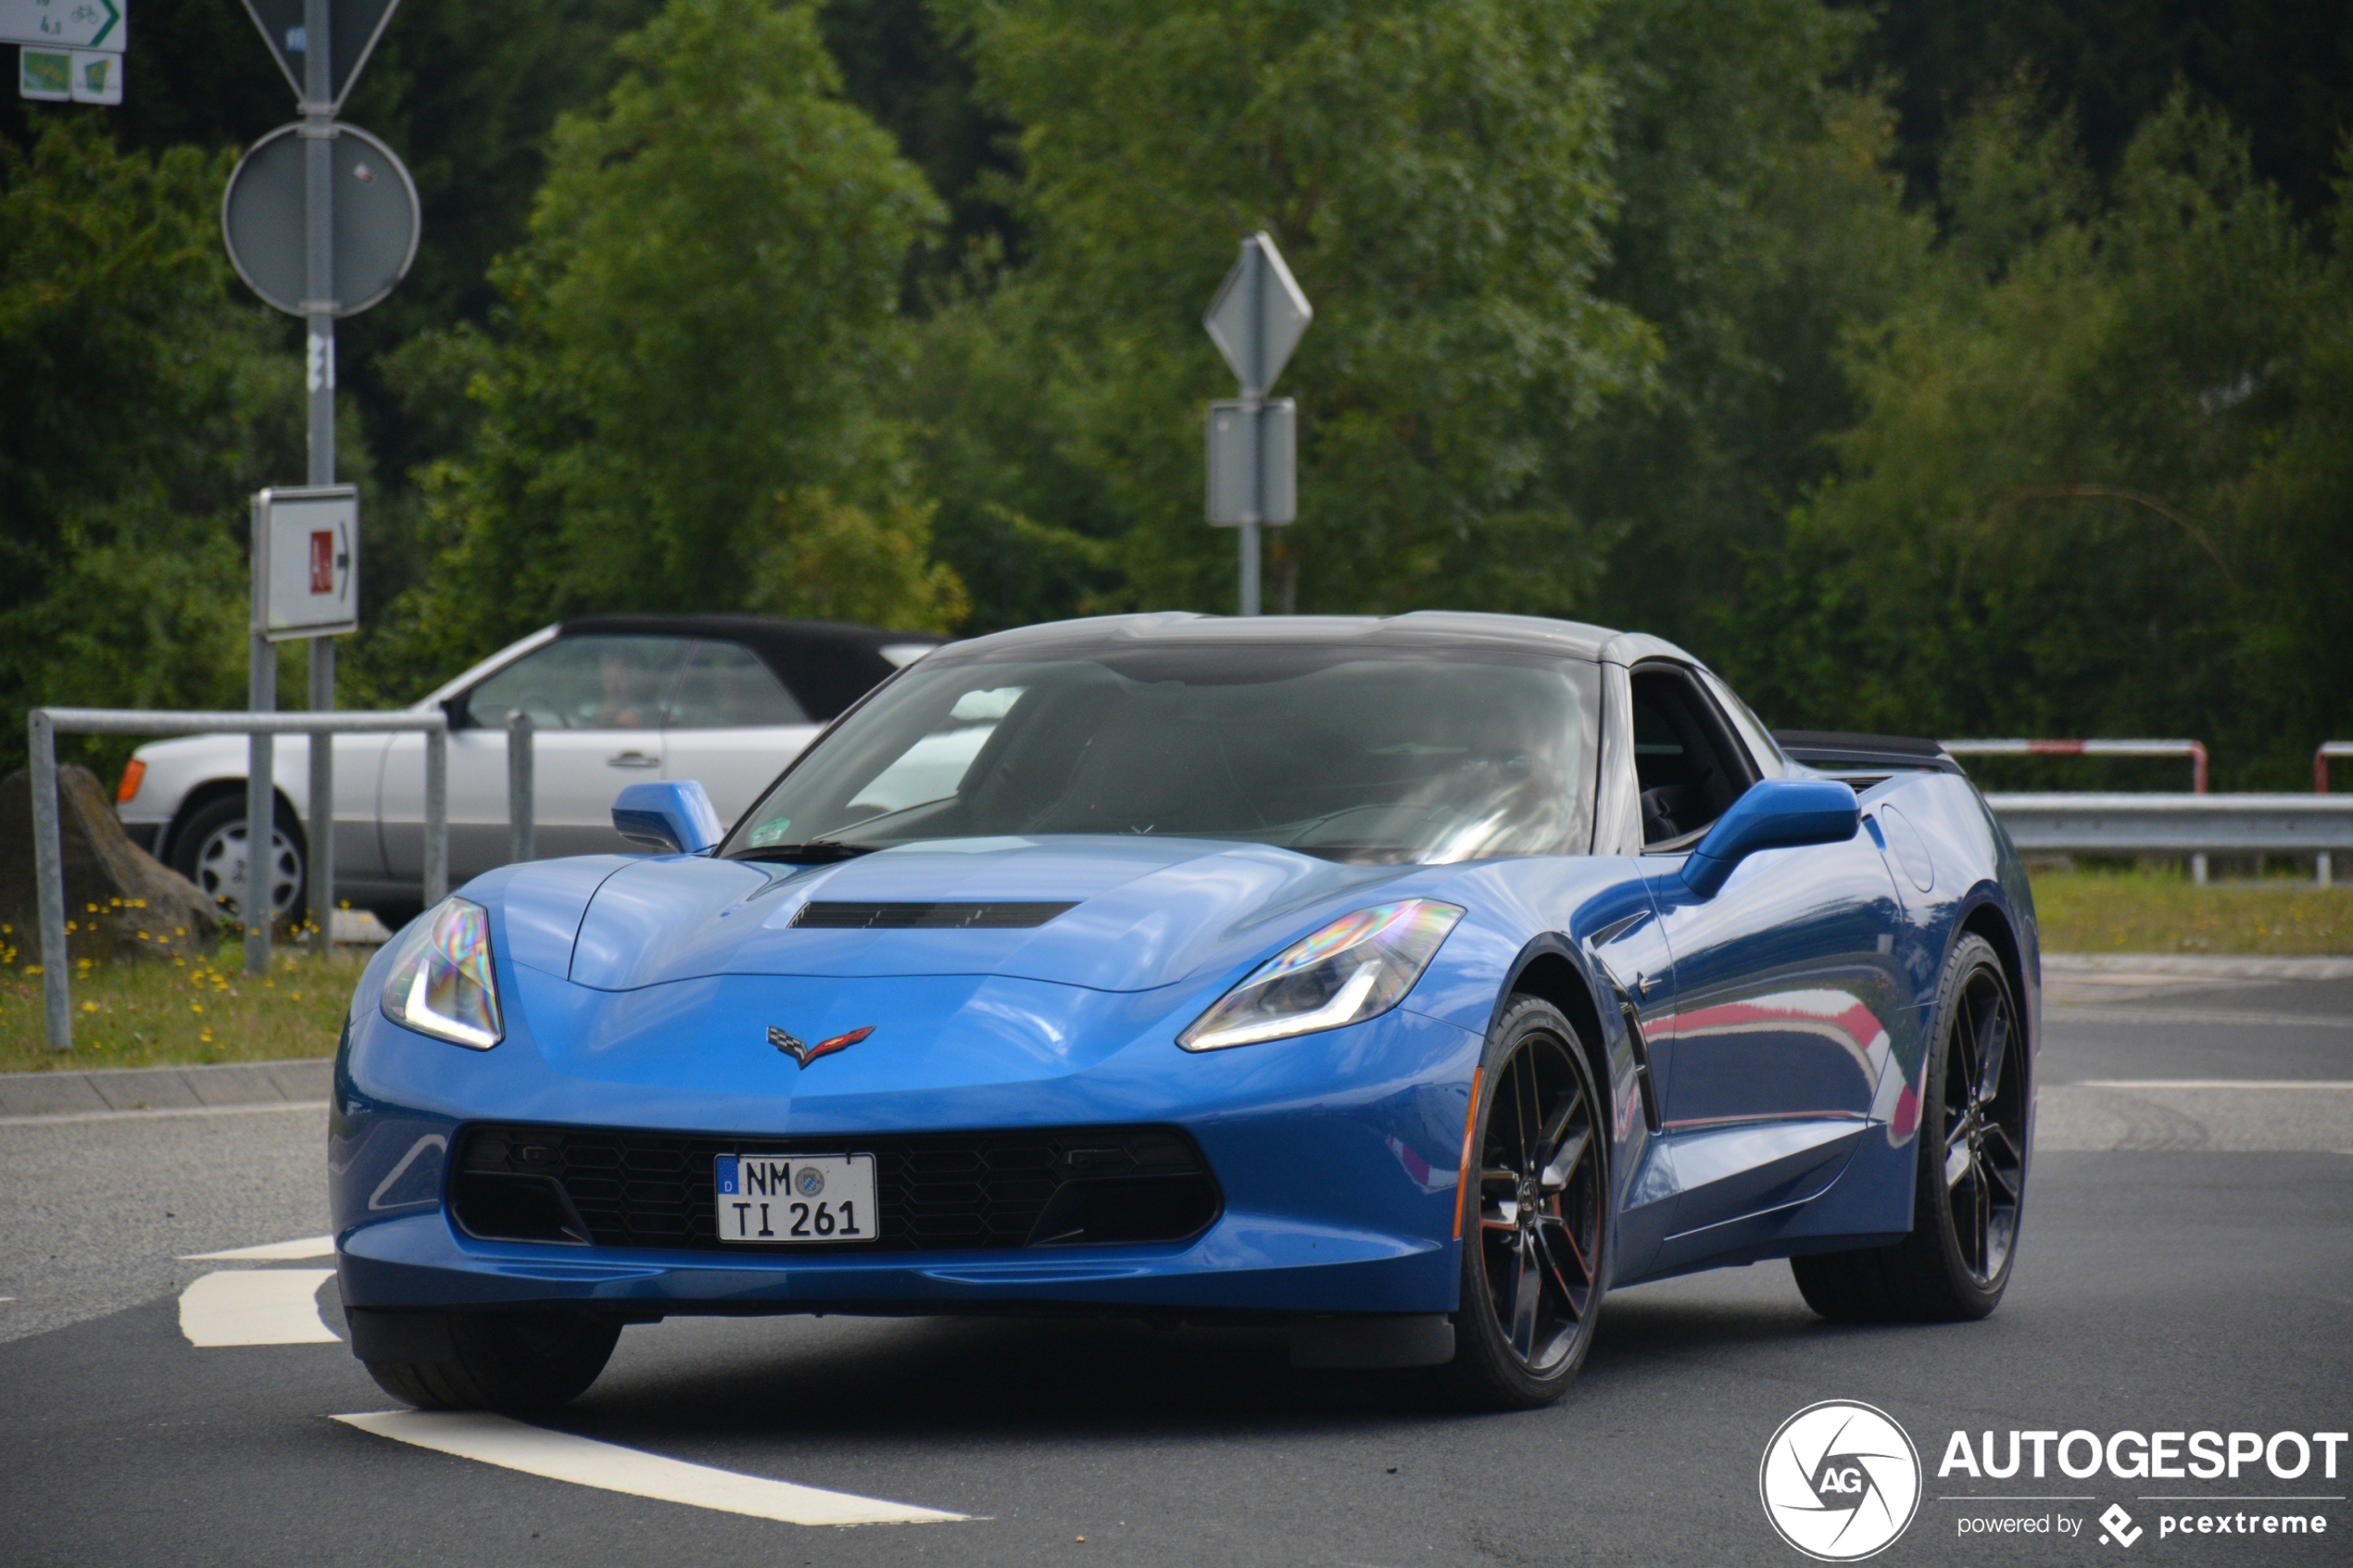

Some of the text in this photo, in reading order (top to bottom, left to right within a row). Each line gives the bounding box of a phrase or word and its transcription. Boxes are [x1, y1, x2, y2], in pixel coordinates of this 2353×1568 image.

[724, 1181, 732, 1192] D
[747, 1161, 791, 1196] NM
[733, 1200, 860, 1236] TI 261
